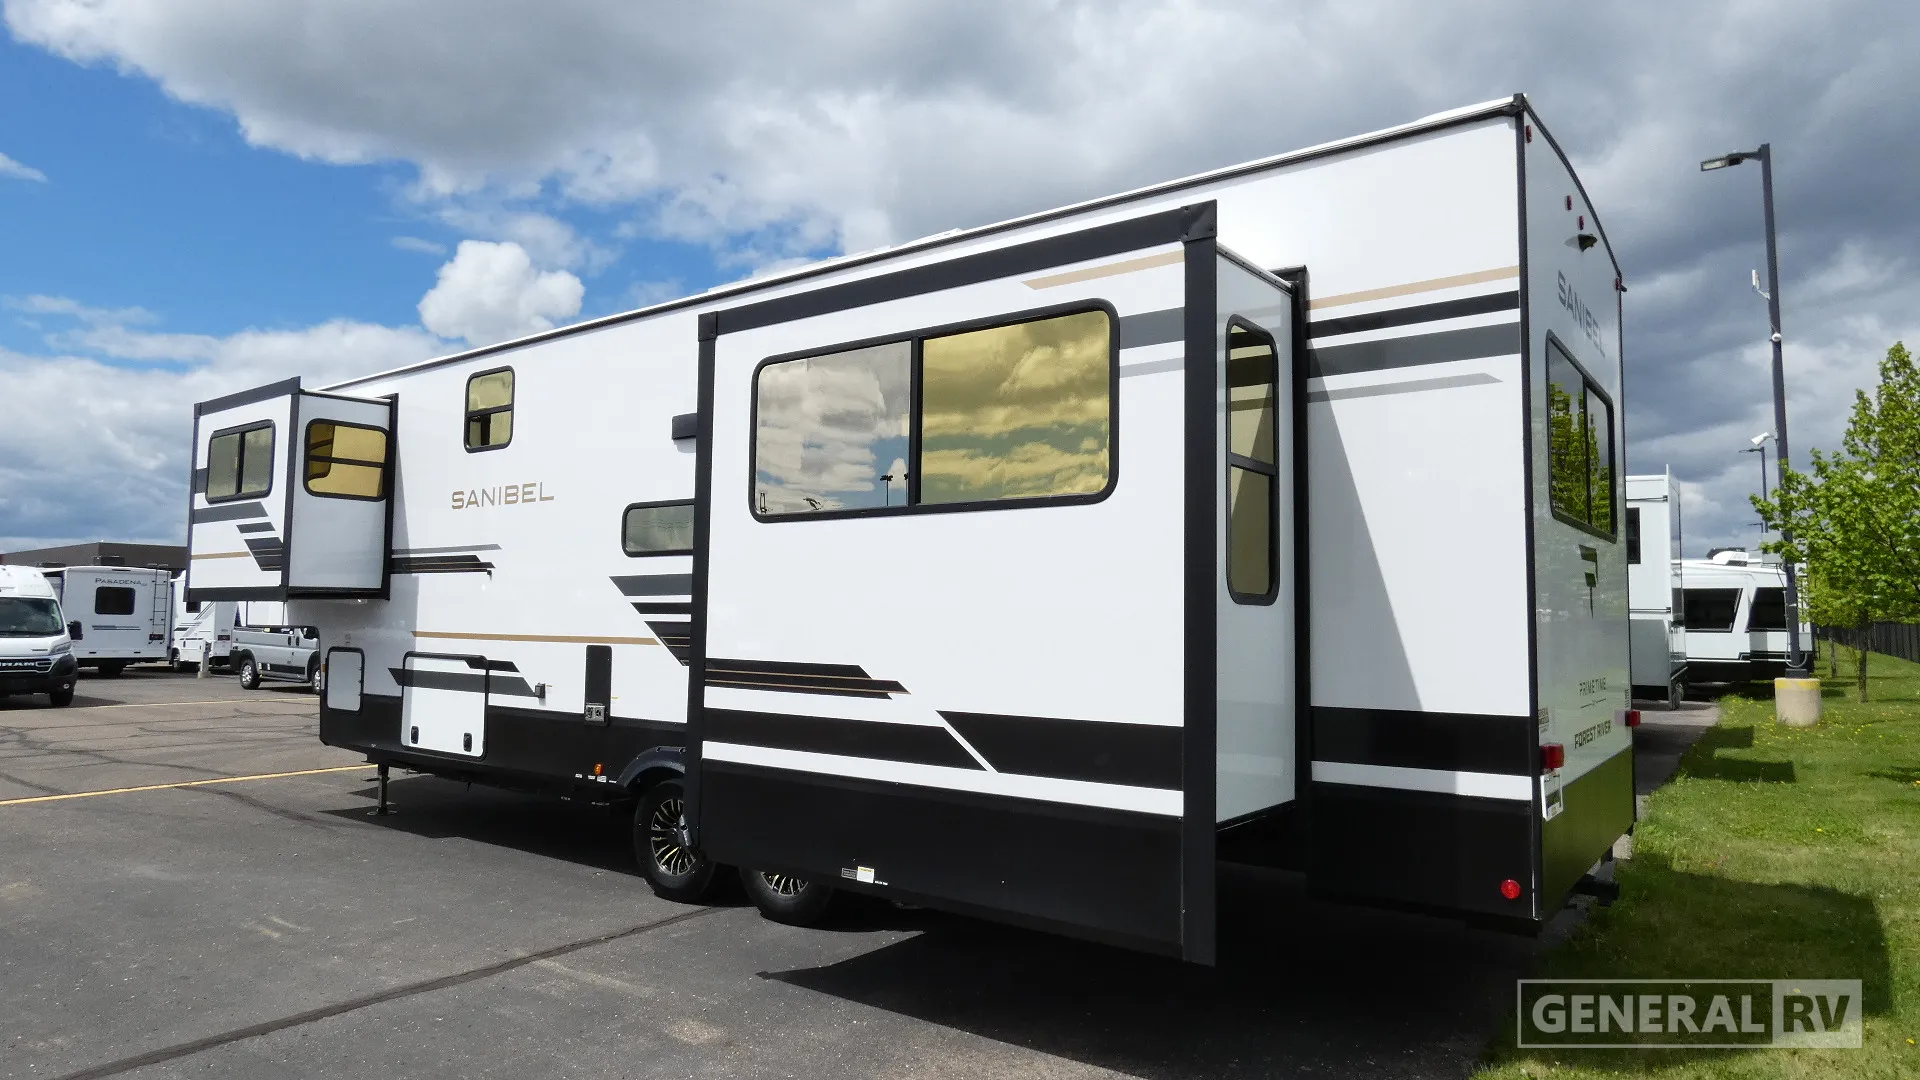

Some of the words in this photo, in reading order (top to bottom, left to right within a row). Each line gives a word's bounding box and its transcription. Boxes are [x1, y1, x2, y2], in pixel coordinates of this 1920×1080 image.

[1558, 269, 1606, 358] SANIBEL
[451, 481, 555, 510] SANIBEL
[1574, 725, 1596, 749] FOREST
[1597, 719, 1612, 738] RIVER
